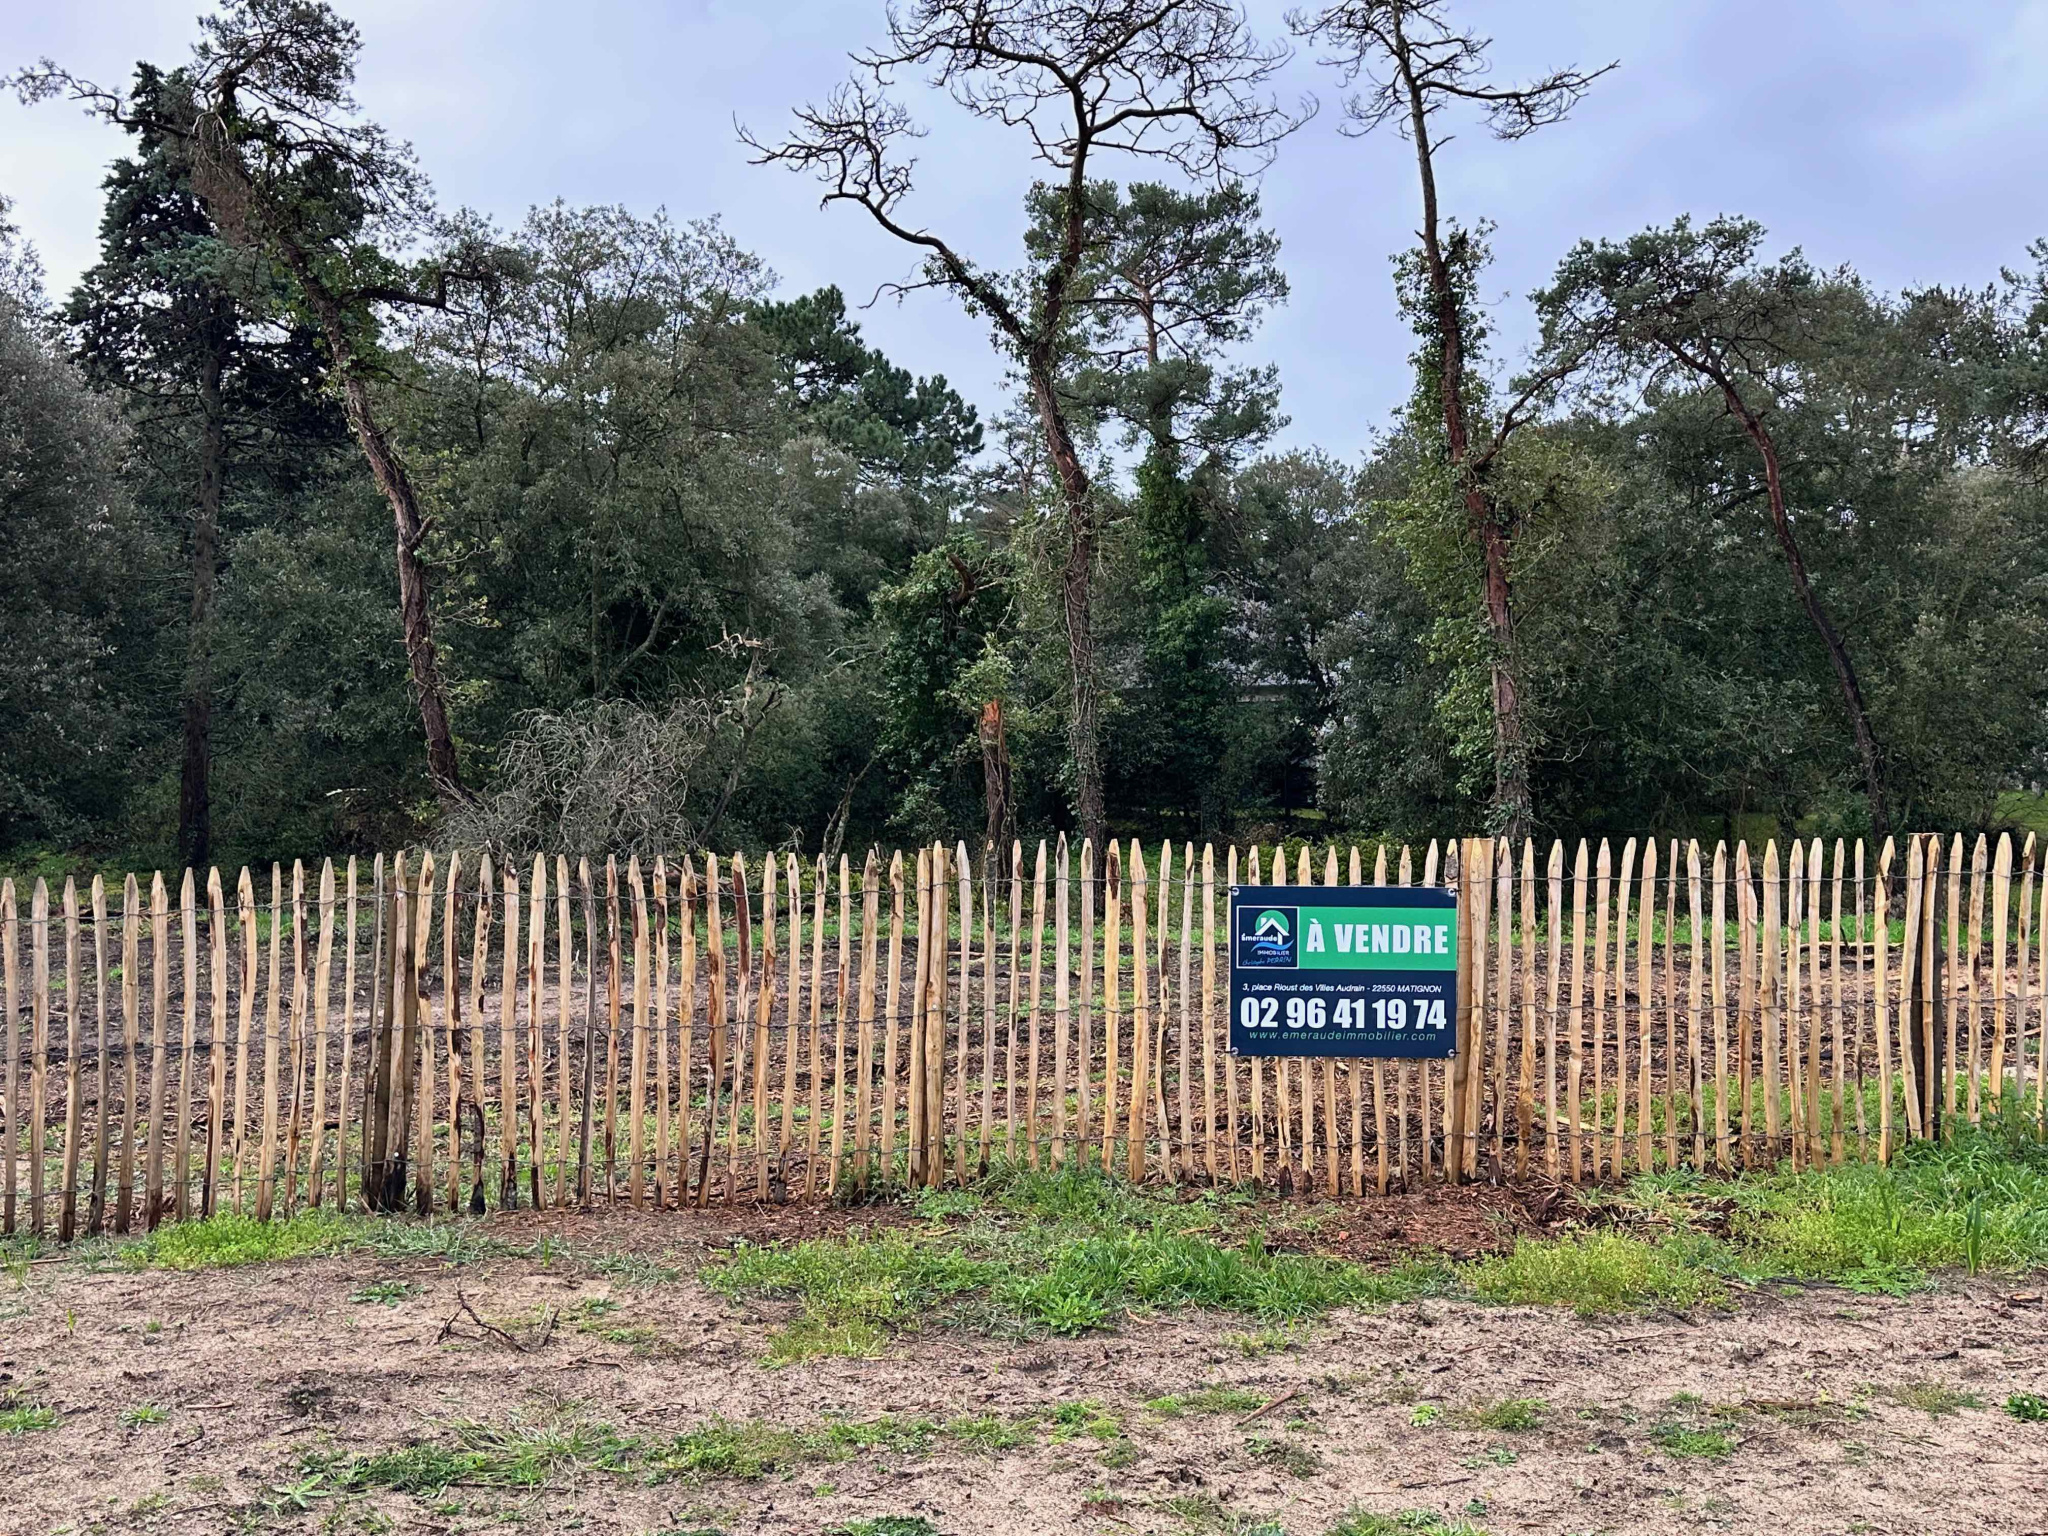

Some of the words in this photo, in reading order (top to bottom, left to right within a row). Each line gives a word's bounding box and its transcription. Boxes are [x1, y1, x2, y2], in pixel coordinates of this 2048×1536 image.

[1306, 918, 1325, 952] À
[1334, 924, 1448, 953] VENDRE
[1242, 983, 1250, 992] 3,
[1251, 983, 1273, 993] place
[1274, 983, 1298, 992] Rioust
[1299, 983, 1314, 992] des
[1315, 983, 1335, 992] Villes
[1336, 984, 1365, 993] Audrain
[1371, 984, 1396, 993] 22550
[1397, 985, 1442, 993] MATIGNON
[1240, 997, 1279, 1028] 02
[1286, 997, 1326, 1028] 96
[1332, 998, 1366, 1029] 41
[1372, 999, 1407, 1030] 19
[1413, 999, 1447, 1030] 74
[1249, 1031, 1436, 1040] www.emeraudeimmobilier.com
